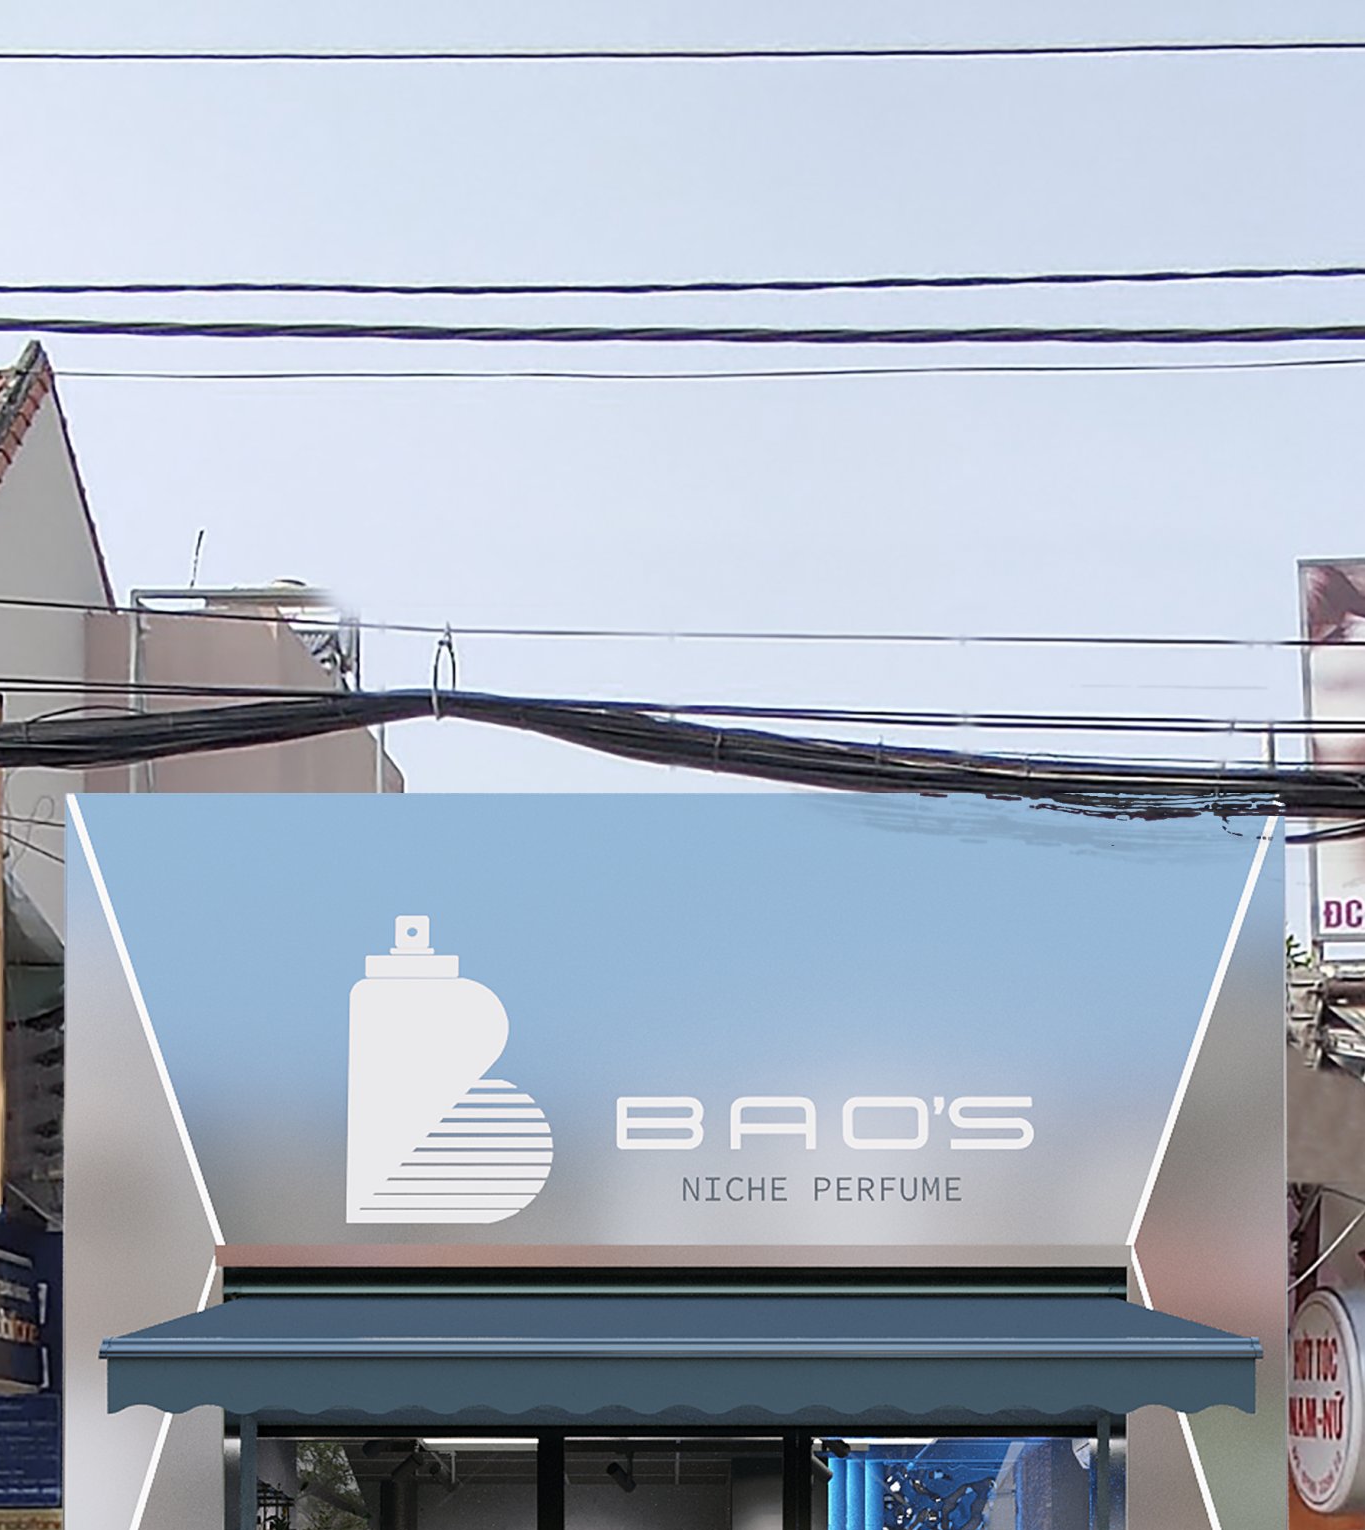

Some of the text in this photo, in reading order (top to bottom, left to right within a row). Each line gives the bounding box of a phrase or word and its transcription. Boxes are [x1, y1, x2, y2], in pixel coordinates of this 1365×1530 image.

[615, 1095, 1035, 1151] BAO'S
[681, 1176, 963, 1203] NICHE PERFUME
